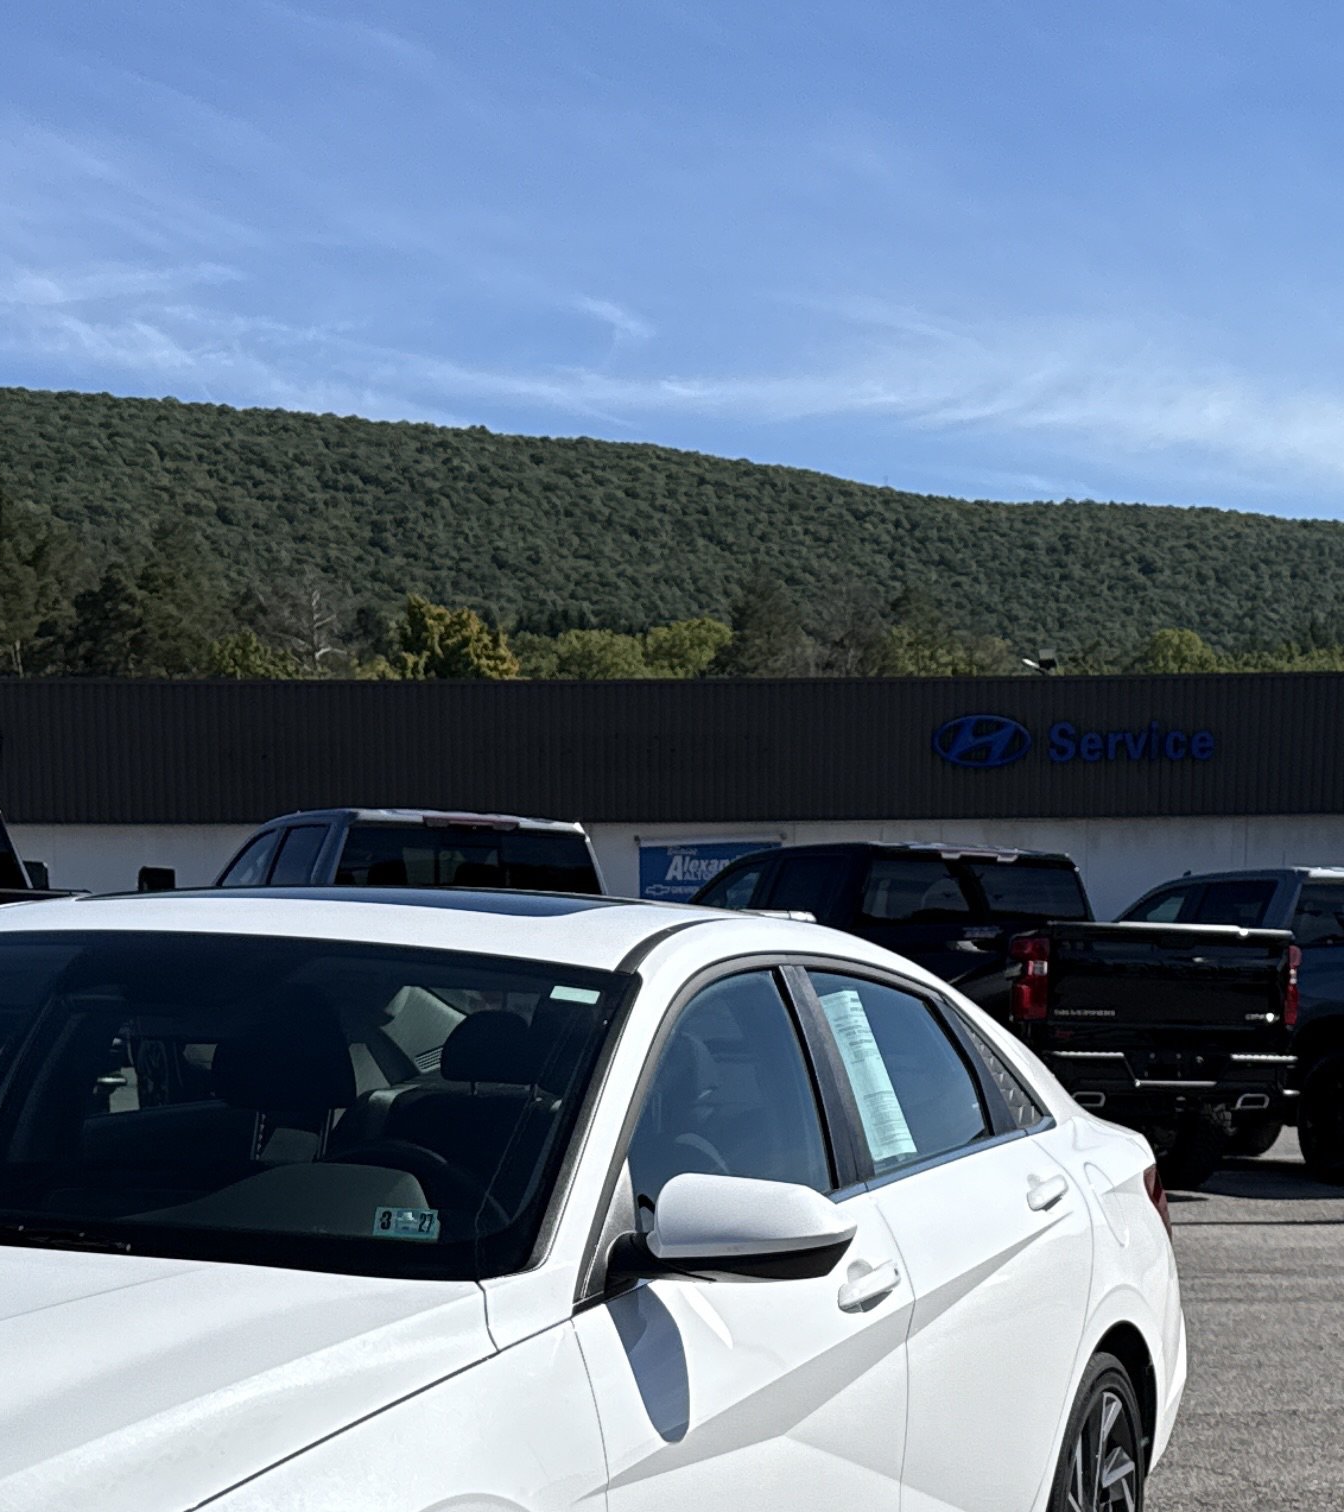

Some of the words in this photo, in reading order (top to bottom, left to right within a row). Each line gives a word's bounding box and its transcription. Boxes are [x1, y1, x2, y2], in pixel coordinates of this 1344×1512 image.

[1048, 720, 1216, 763] Service
[665, 855, 742, 881] Alexan
[379, 1209, 393, 1230] 3
[417, 1212, 434, 1233] 27
